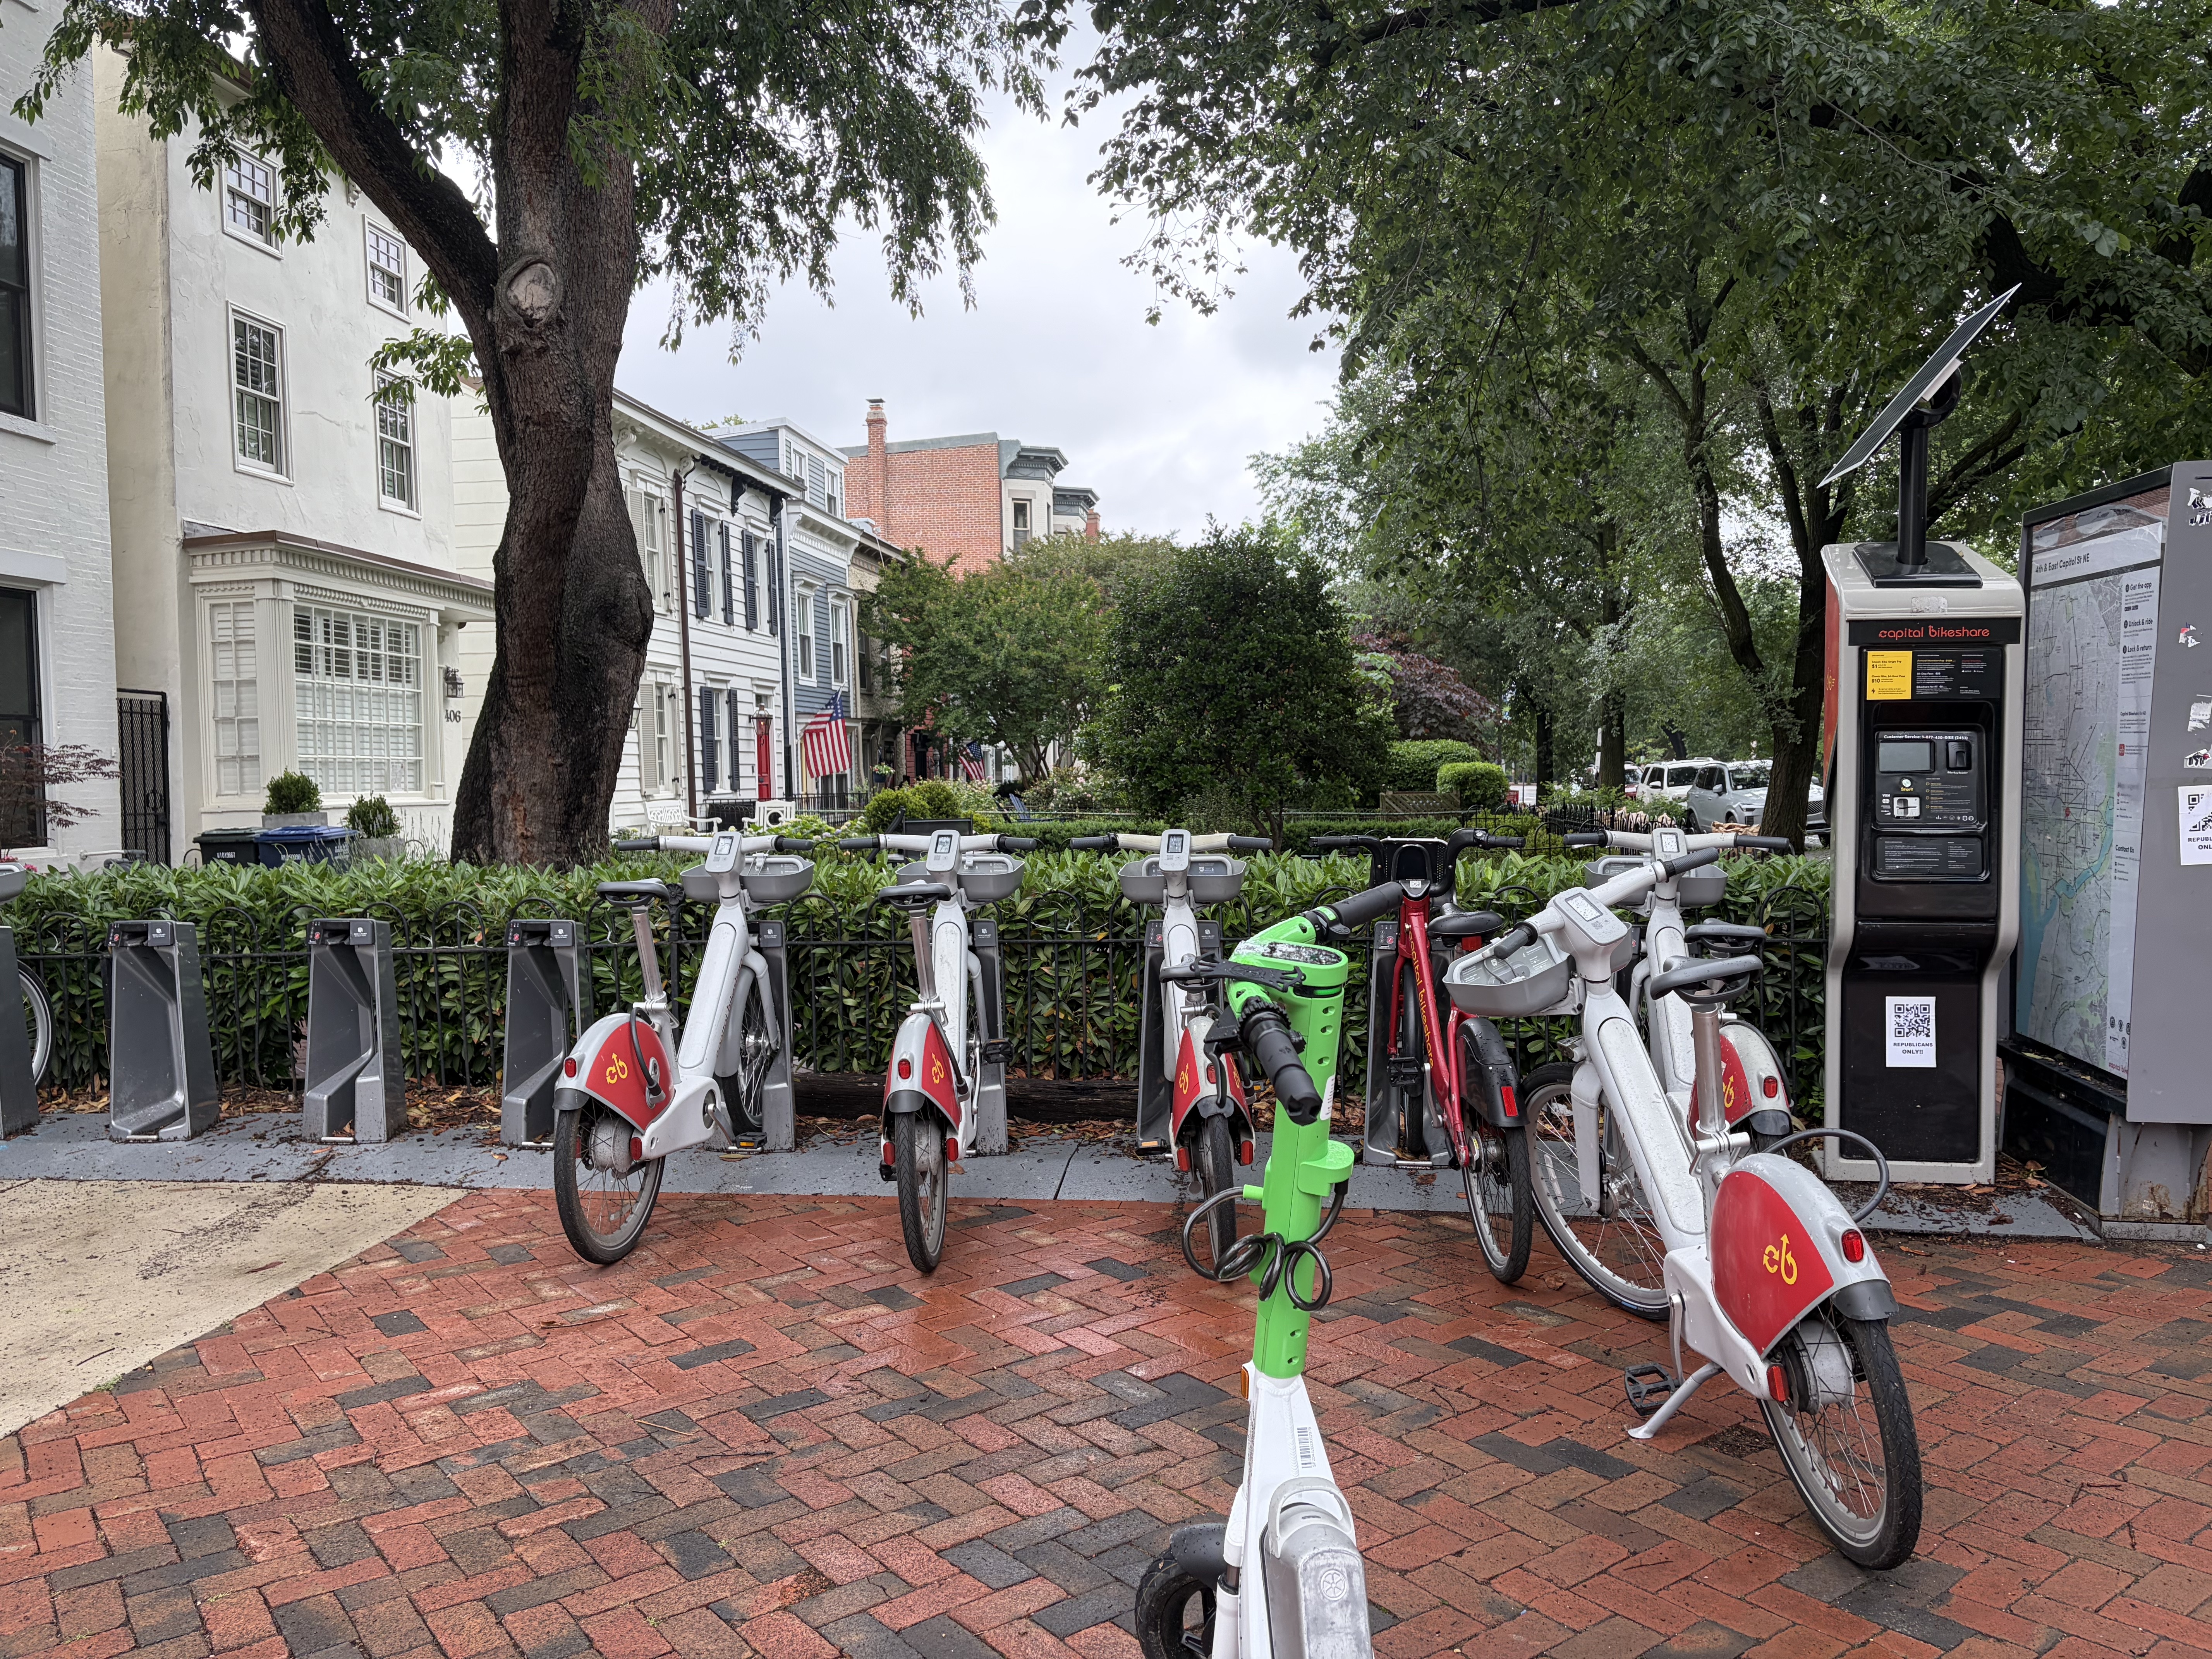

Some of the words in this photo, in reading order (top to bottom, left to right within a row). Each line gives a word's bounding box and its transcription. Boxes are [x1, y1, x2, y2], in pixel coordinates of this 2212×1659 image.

[2044, 563, 2047, 572] &
[2049, 562, 2058, 570] East
[2059, 556, 2076, 569] Capitol
[2077, 555, 2082, 564] St
[2083, 553, 2090, 563] NE
[1879, 628, 1923, 640] capital
[1928, 625, 1990, 637] bikeshare
[445, 709, 461, 723] 406
[1409, 930, 1423, 986] capital
[1419, 988, 1434, 1068] bikeshare
